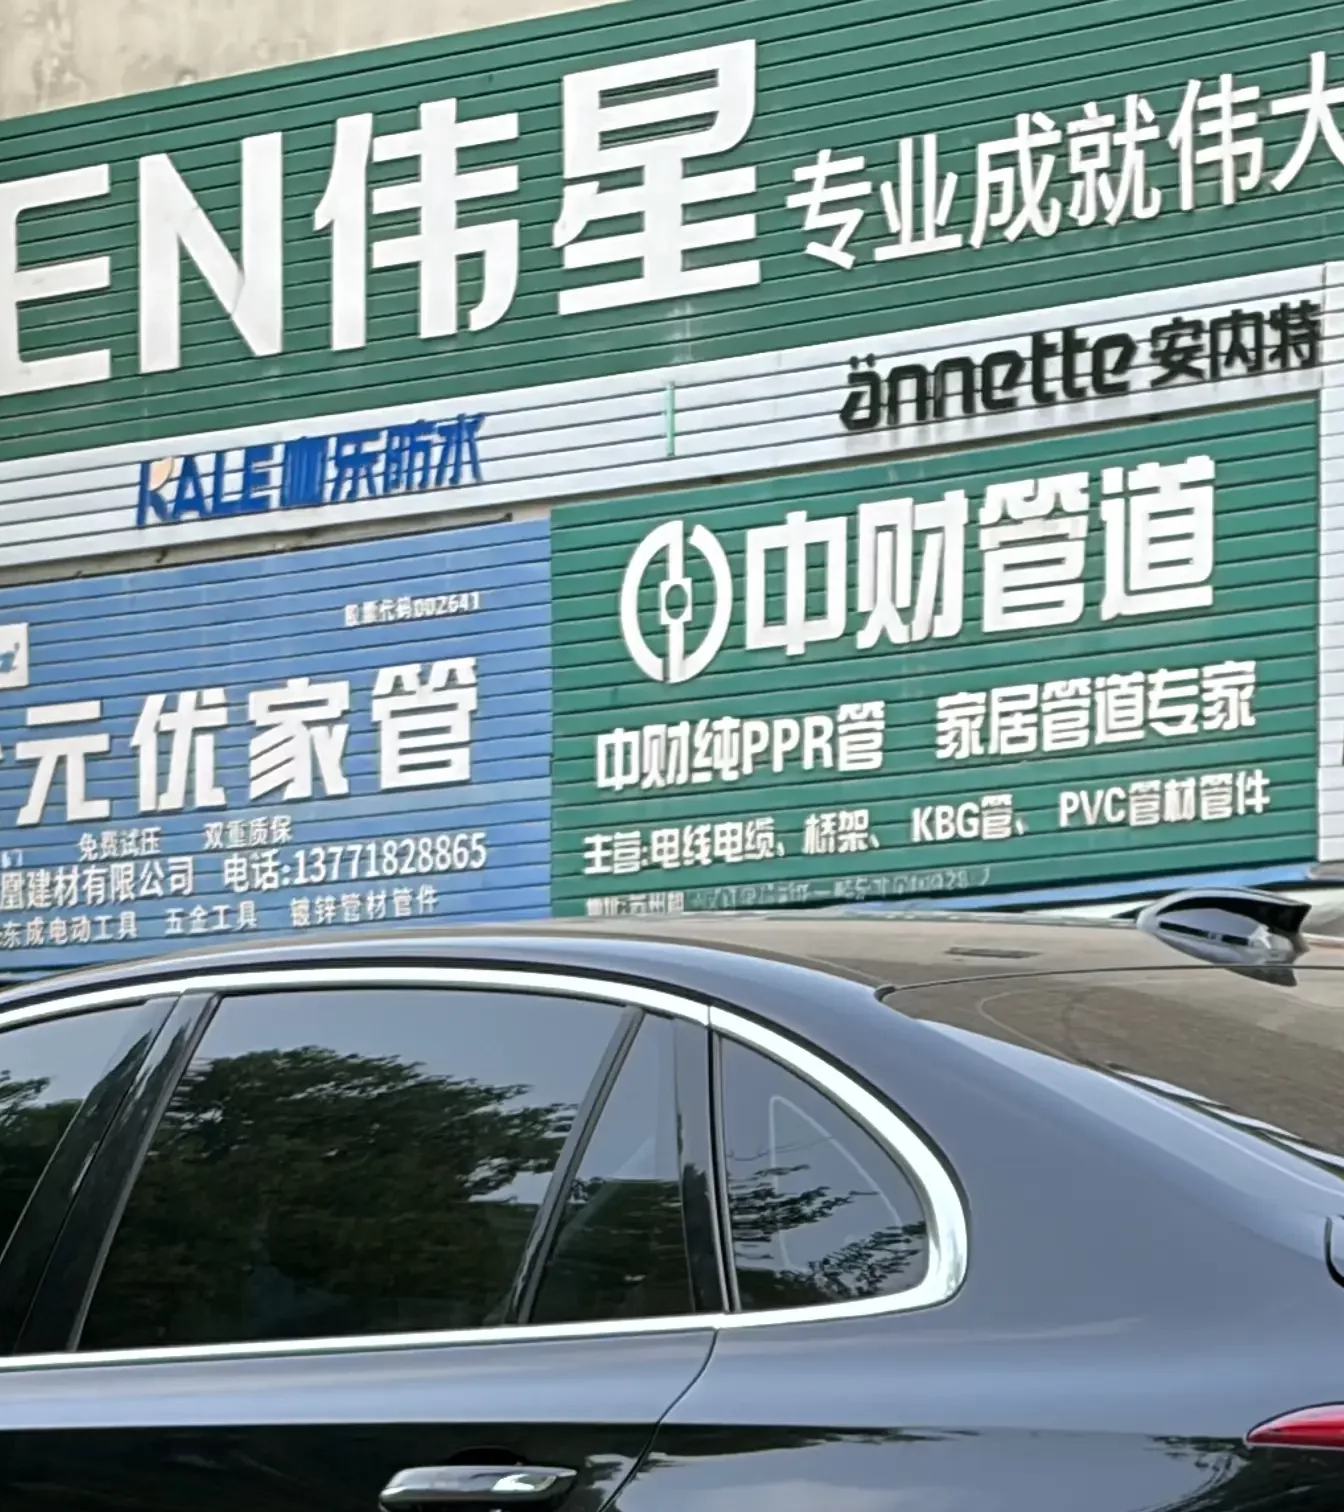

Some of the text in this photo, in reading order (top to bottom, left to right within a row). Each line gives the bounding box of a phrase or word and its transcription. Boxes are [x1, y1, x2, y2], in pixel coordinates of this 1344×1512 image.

[744, 455, 1216, 656] 中财管道
[596, 660, 1257, 792] 中财纯PPR管 家居管道专家
